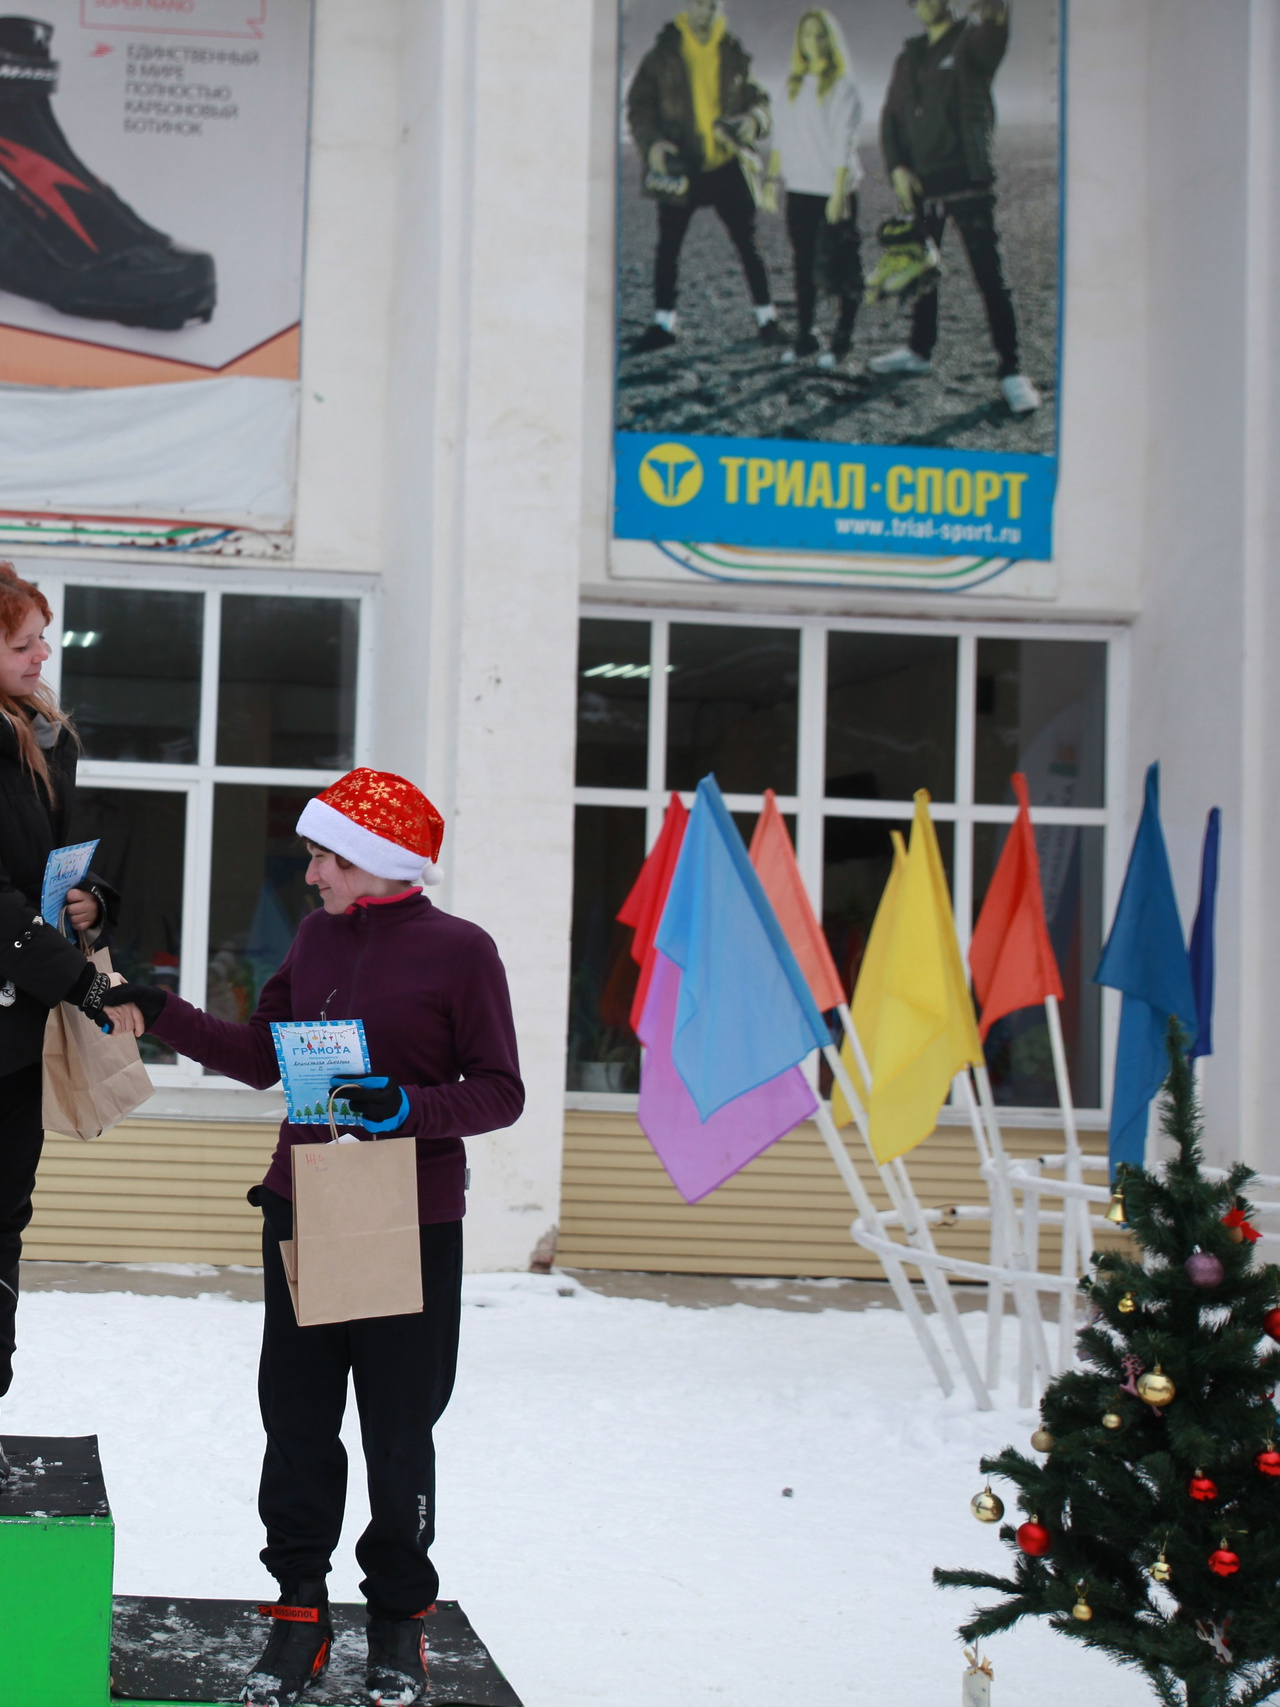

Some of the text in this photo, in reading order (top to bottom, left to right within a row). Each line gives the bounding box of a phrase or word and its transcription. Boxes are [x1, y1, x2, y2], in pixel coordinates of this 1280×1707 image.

[126, 43, 260, 66] ЕДИНСТВЕННЫЙ
[126, 62, 183, 81] В МИРЕ
[125, 80, 232, 102] ПОЛНОСТЬЮ
[124, 100, 239, 120] КАРБОНОВЫЙ
[124, 117, 203, 137] БОТИНОК
[834, 516, 1022, 545] www.trial-sport.ru
[292, 1046, 351, 1056] ГРАМОТА
[417, 1494, 427, 1531] FILA
